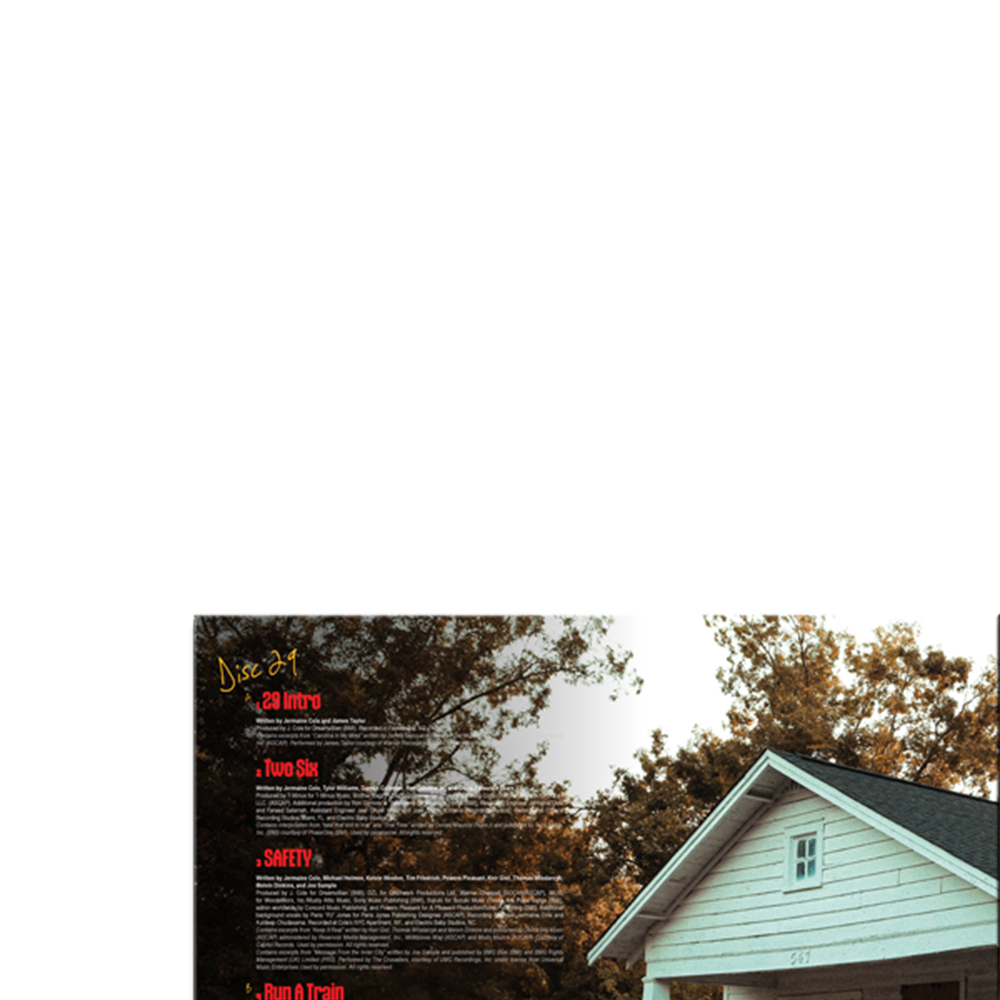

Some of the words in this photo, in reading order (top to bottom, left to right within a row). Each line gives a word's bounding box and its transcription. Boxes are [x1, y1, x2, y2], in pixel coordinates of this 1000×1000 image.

[217, 656, 263, 693] Disc
[268, 648, 298, 677] 29
[262, 690, 280, 710] 29
[284, 692, 322, 710] Intro
[264, 758, 294, 778] Two
[296, 758, 318, 778] Six
[264, 848, 312, 868] SAFETY
